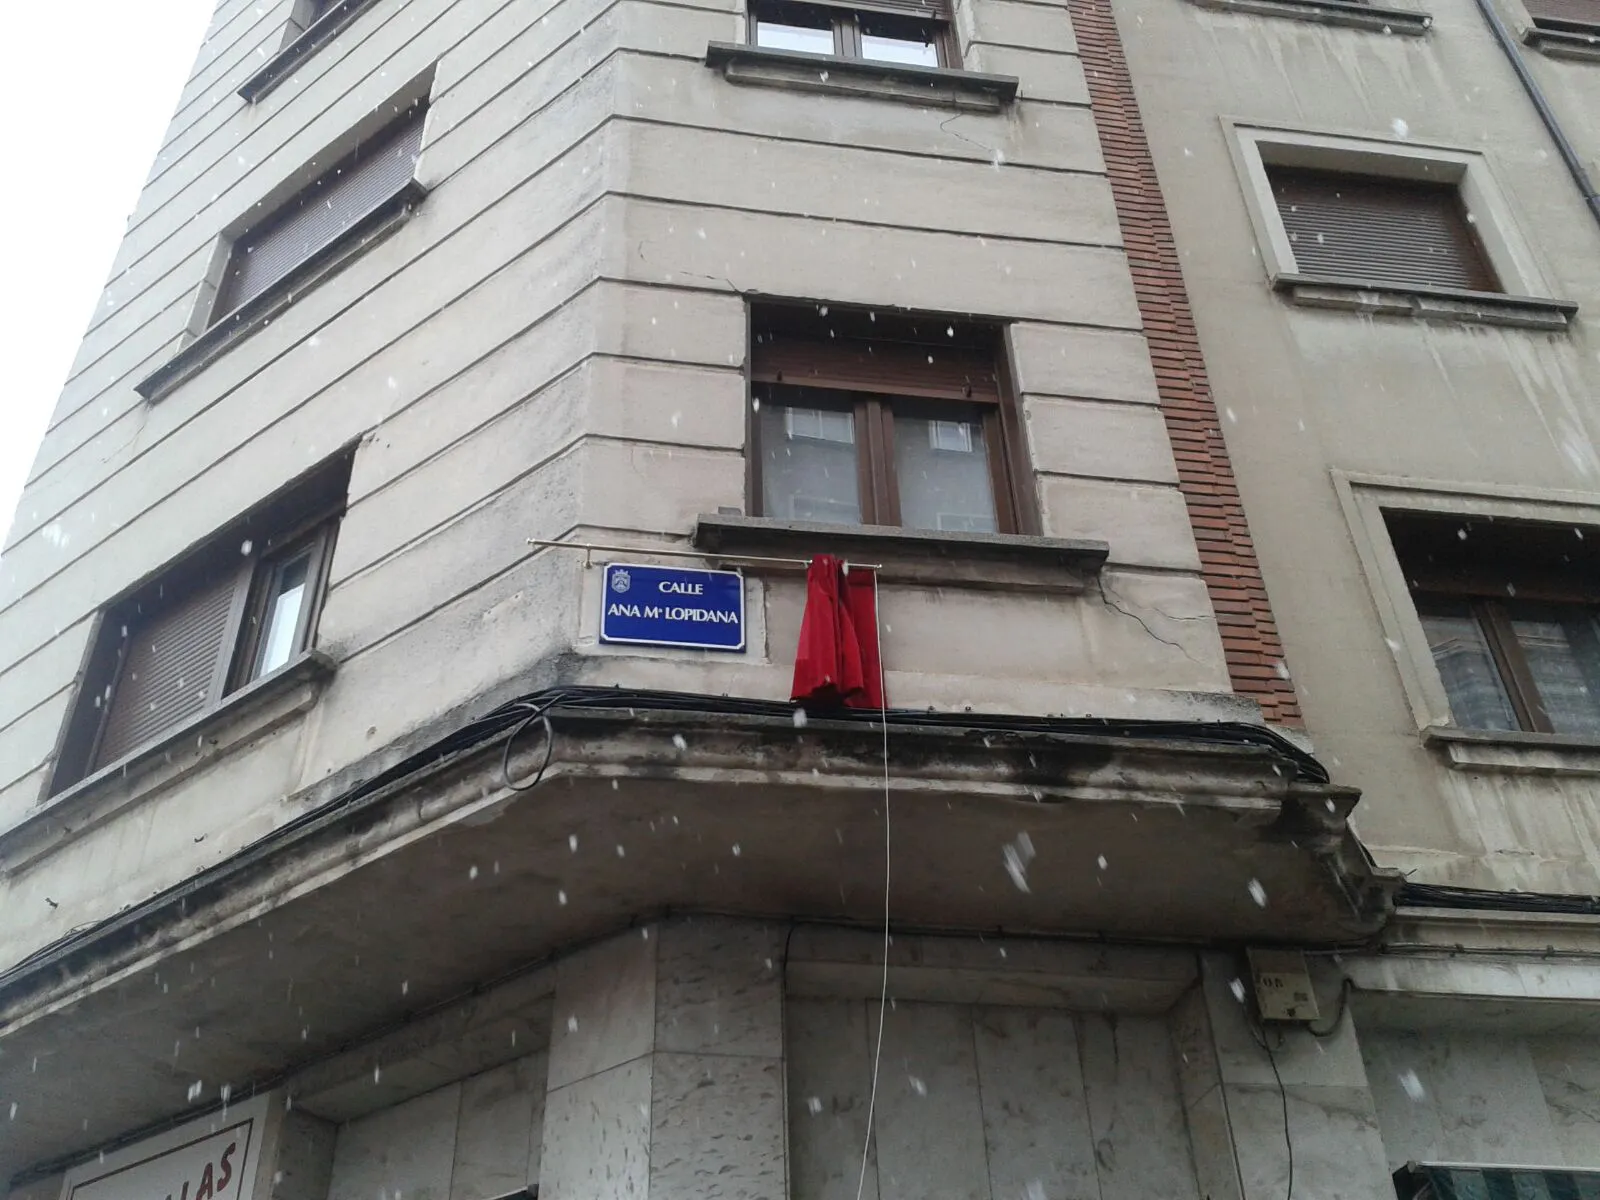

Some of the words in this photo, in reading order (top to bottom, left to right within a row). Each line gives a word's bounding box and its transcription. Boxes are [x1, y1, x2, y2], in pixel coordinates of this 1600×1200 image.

[658, 581, 703, 595] CALLE
[607, 603, 641, 618] ANA
[665, 606, 739, 624] LOPIDANA
